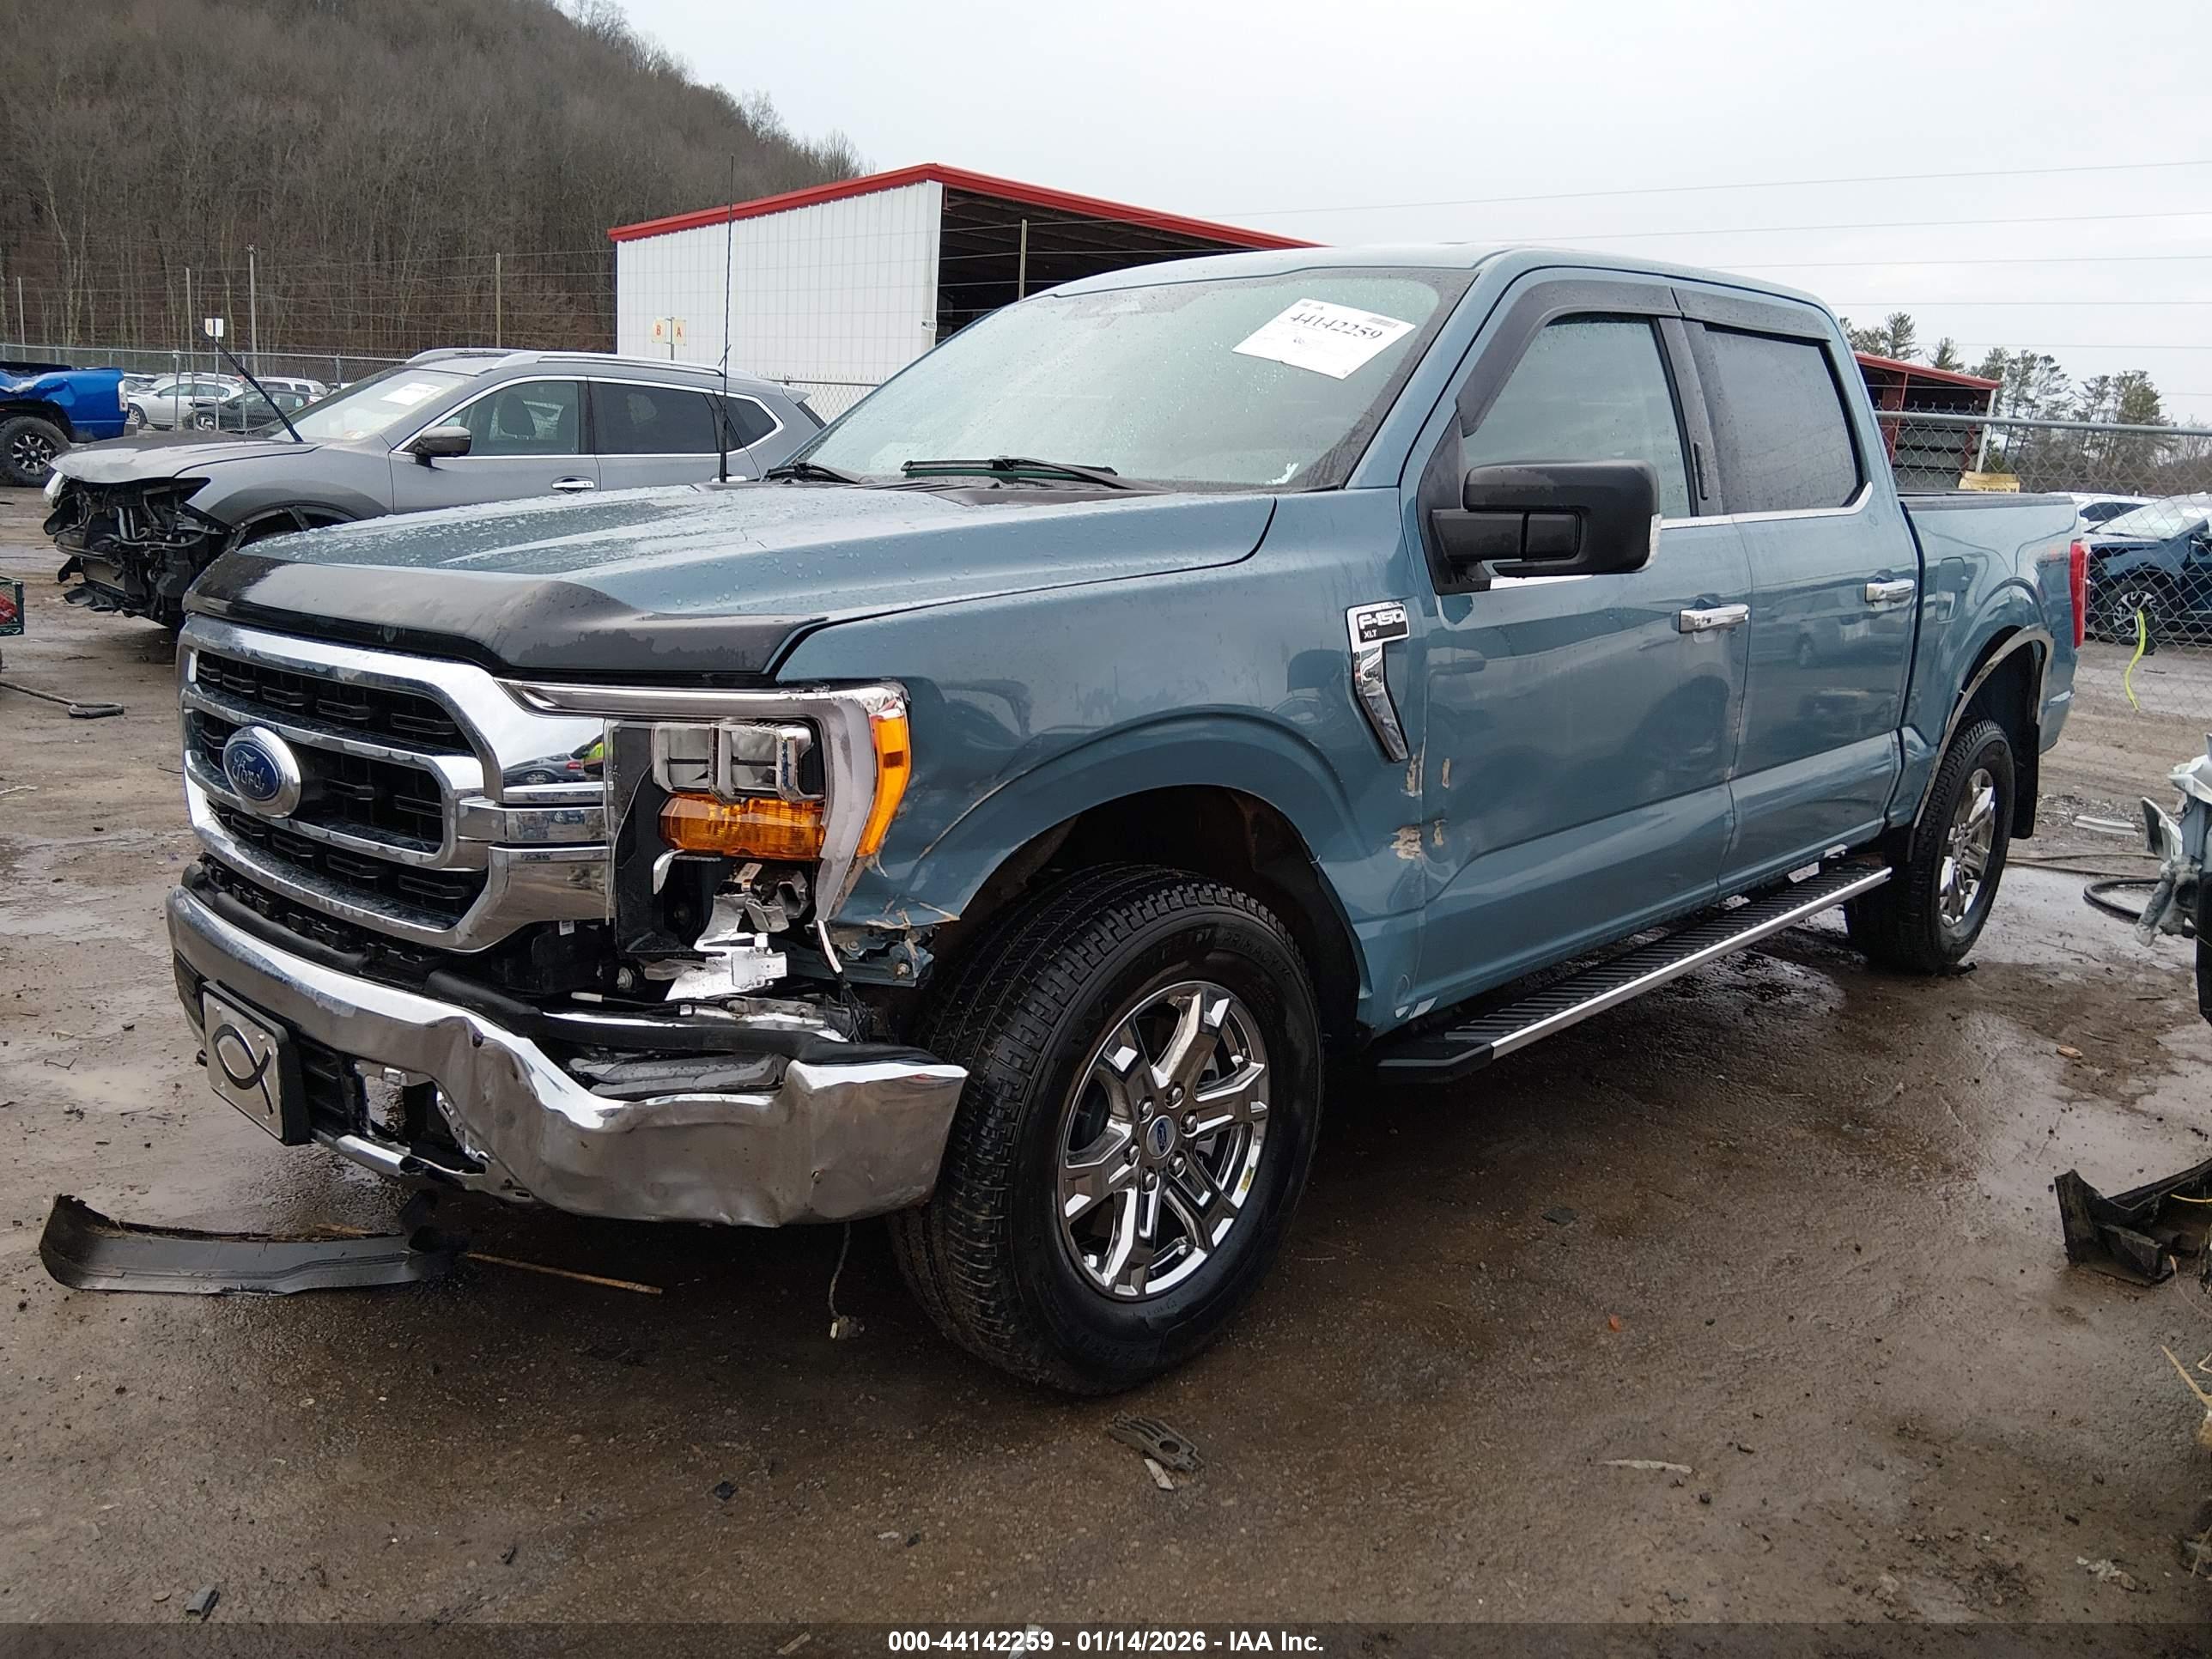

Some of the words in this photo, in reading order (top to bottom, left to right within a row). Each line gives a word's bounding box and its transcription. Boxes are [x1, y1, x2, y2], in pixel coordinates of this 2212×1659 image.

[656, 325, 661, 336] B
[677, 326, 682, 337] A
[1290, 313, 1383, 340] 44142259
[1358, 609, 1406, 629] F-150
[1364, 629, 1377, 640] XLT
[231, 749, 266, 792] Ford
